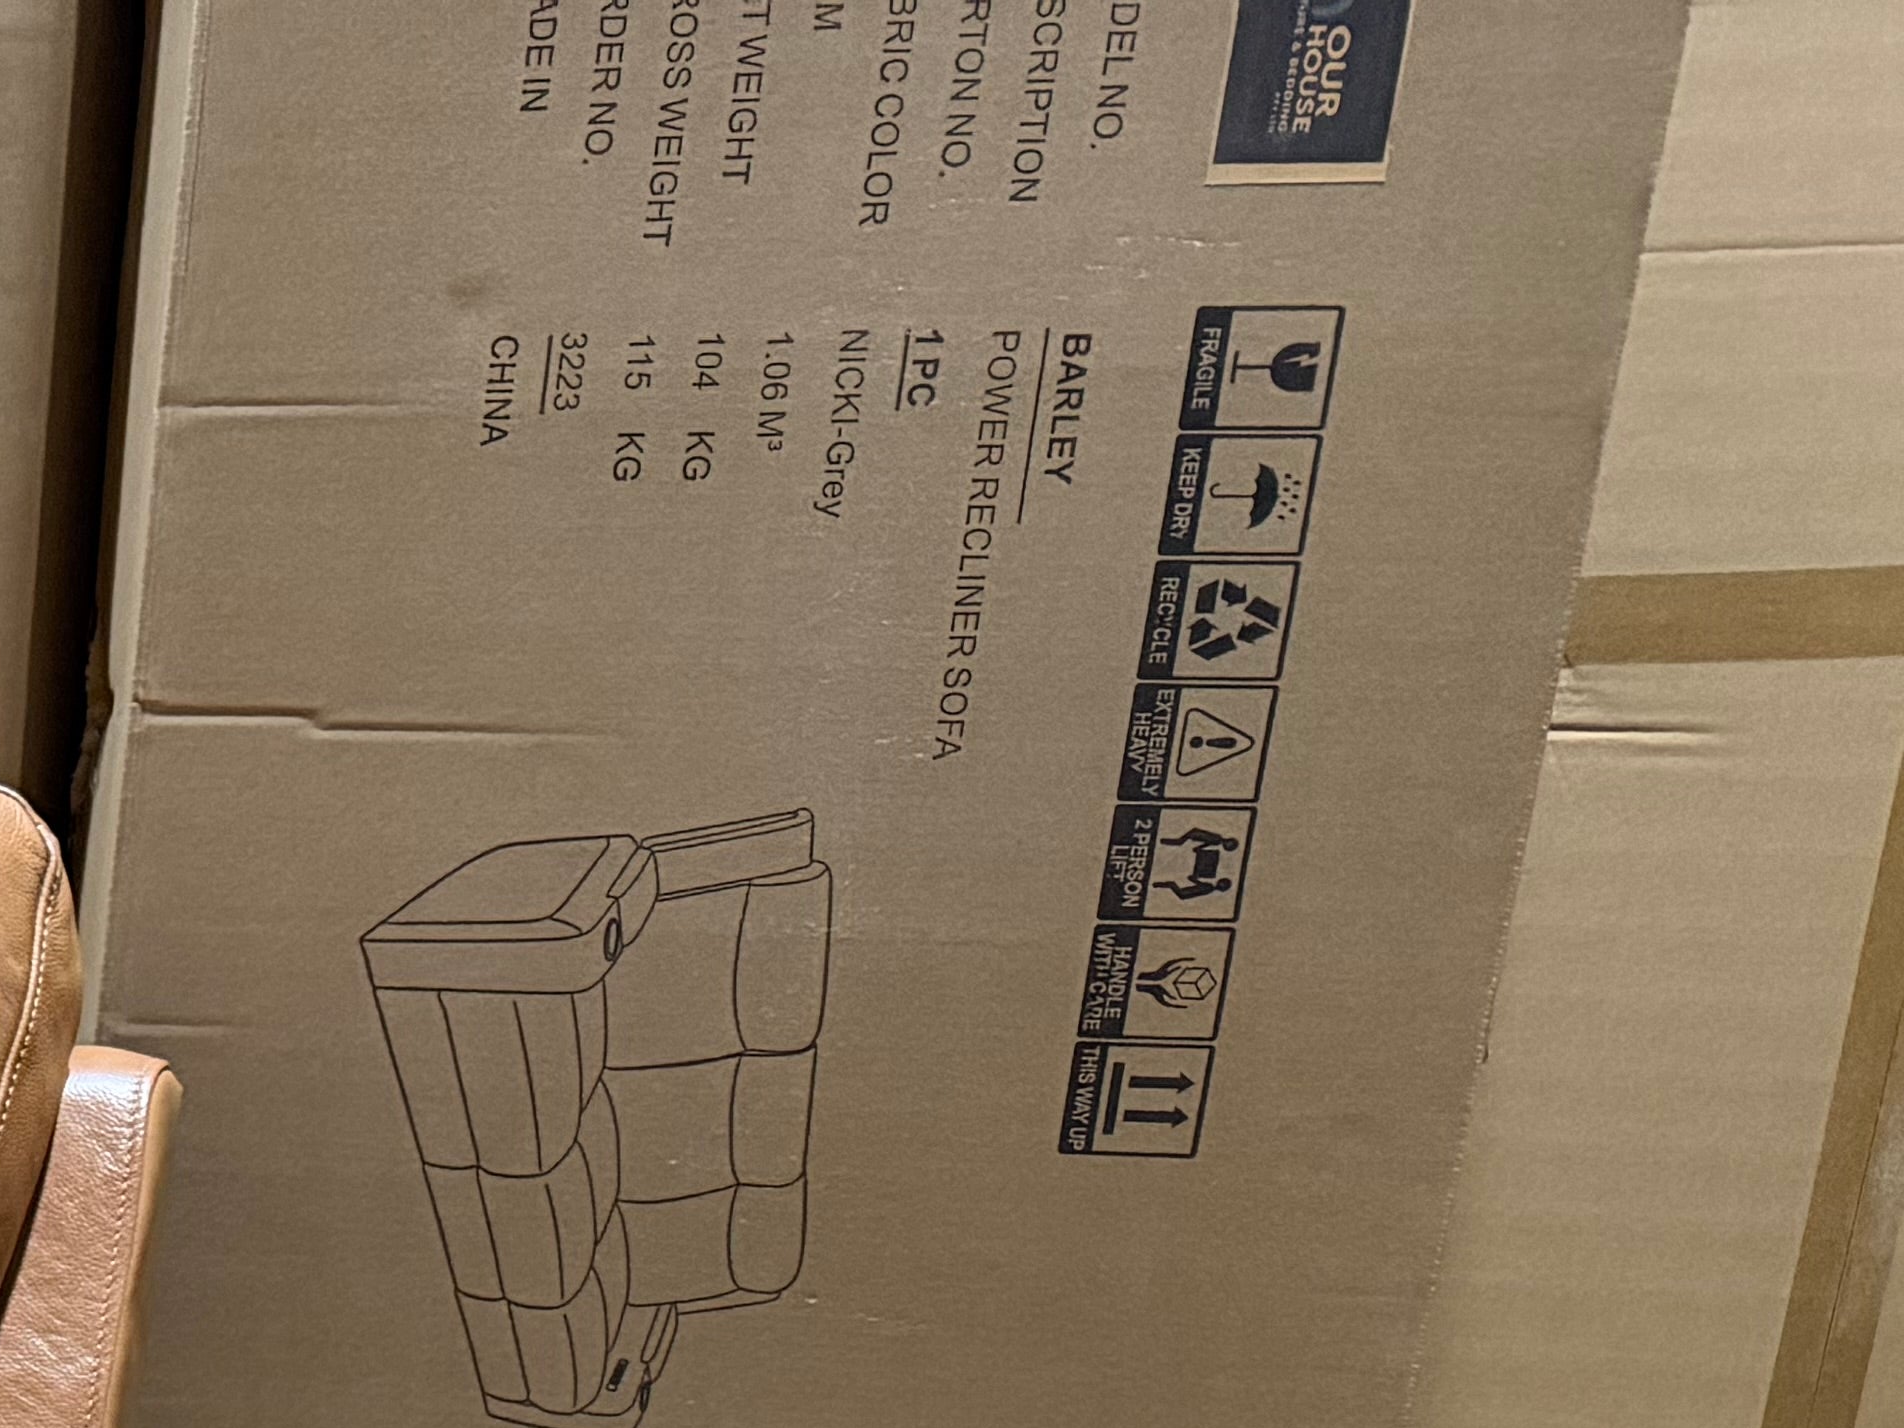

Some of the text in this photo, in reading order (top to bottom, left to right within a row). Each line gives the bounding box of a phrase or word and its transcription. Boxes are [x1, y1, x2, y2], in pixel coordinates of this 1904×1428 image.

[520, 0, 558, 112] ADE IN
[582, 0, 629, 164] RDER NO.
[722, 34, 768, 184] WEIGHT
[938, 0, 991, 177] RTON NO.
[1008, 0, 1066, 202] SCRIPTION
[1090, 2, 1140, 150] DEL NO.
[1278, 57, 1299, 133] BEDDING
[1292, 24, 1328, 134] HOUSE
[1314, 25, 1352, 117] OUR
[858, 0, 917, 227] BRIC COLOR
[643, 98, 689, 247] WEIGHT
[480, 335, 519, 446] CHINA
[553, 332, 588, 411] 3223
[613, 335, 656, 482] 115 KG
[682, 333, 726, 481] 104 KG
[760, 331, 794, 401] 1.06
[907, 329, 944, 407] 1 PC
[1044, 333, 1091, 485] BARLEY
[1190, 327, 1222, 411] FRAGILE
[813, 330, 869, 518] NICKI-Grey
[932, 330, 1021, 762] POWER RECLINER SOFA
[1168, 447, 1203, 540] KEEP DRY
[1148, 577, 1180, 664] RECYCLE
[1127, 712, 1152, 772] HEAVY
[1142, 688, 1175, 797] EXTREMELY
[1110, 845, 1129, 882] LIFT
[1121, 819, 1153, 907] 2 PERSON
[1104, 946, 1132, 1019] HANDLE
[1068, 1045, 1100, 1151] THIS WAY UP
